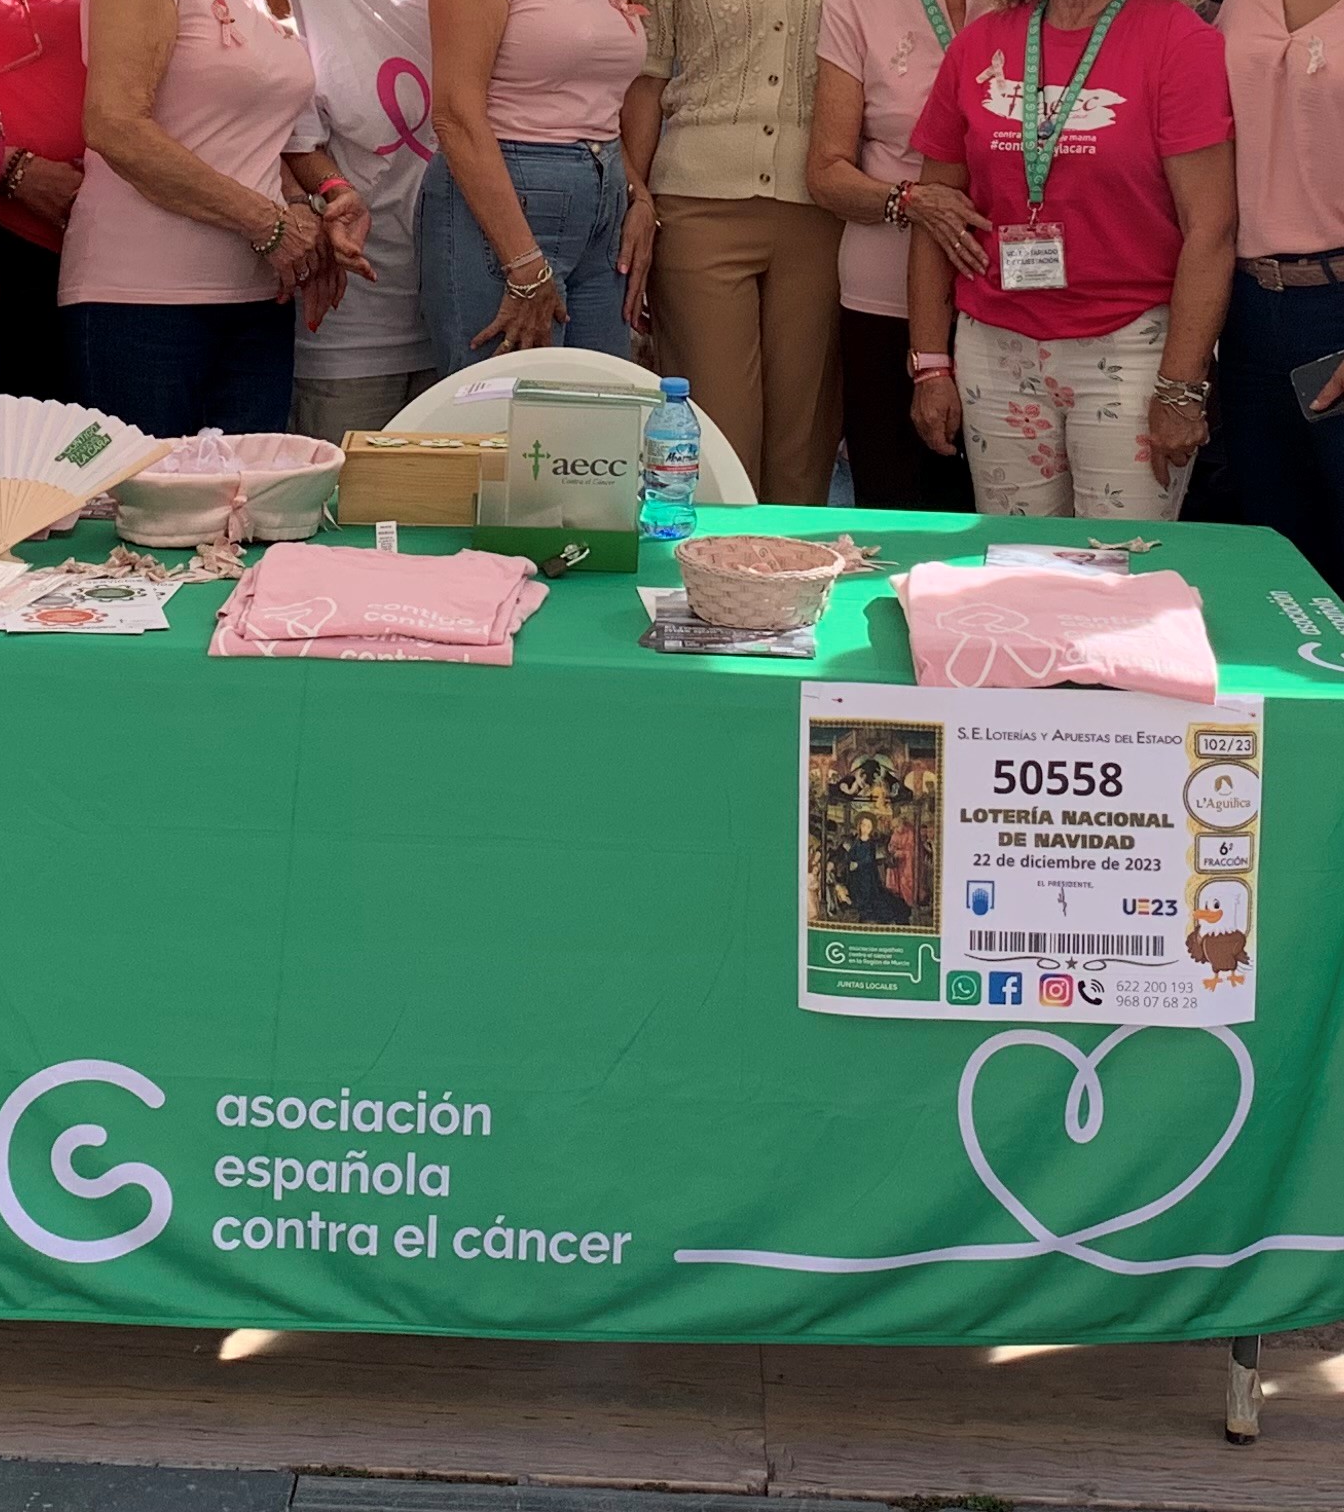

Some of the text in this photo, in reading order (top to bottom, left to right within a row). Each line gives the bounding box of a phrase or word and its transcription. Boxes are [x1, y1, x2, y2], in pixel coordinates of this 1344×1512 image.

[993, 130, 1022, 139] contra
[552, 456, 627, 478] aecc
[1051, 729, 1110, 743] APUESTAS
[1115, 734, 1134, 744] DEL
[1136, 731, 1183, 745] ESTADO
[1203, 737, 1252, 752] 102/23
[993, 759, 1124, 797] 50558
[959, 805, 1175, 829] LOTERÍA NACIONAL
[998, 832, 1136, 850] DE NAVIDAD
[973, 853, 1162, 872] 22 de diciembre de 2023
[1203, 856, 1249, 867] FRACCIÓN
[1122, 898, 1178, 916] UE23
[837, 980, 898, 991] JUNTAS LOCALES
[1116, 979, 1194, 994] 622 200 193
[1116, 994, 1198, 1009] 968 07 68 28
[215, 1087, 492, 1136] asociación
[214, 1149, 451, 1201] española
[212, 1211, 633, 1265] contra el cáncer
